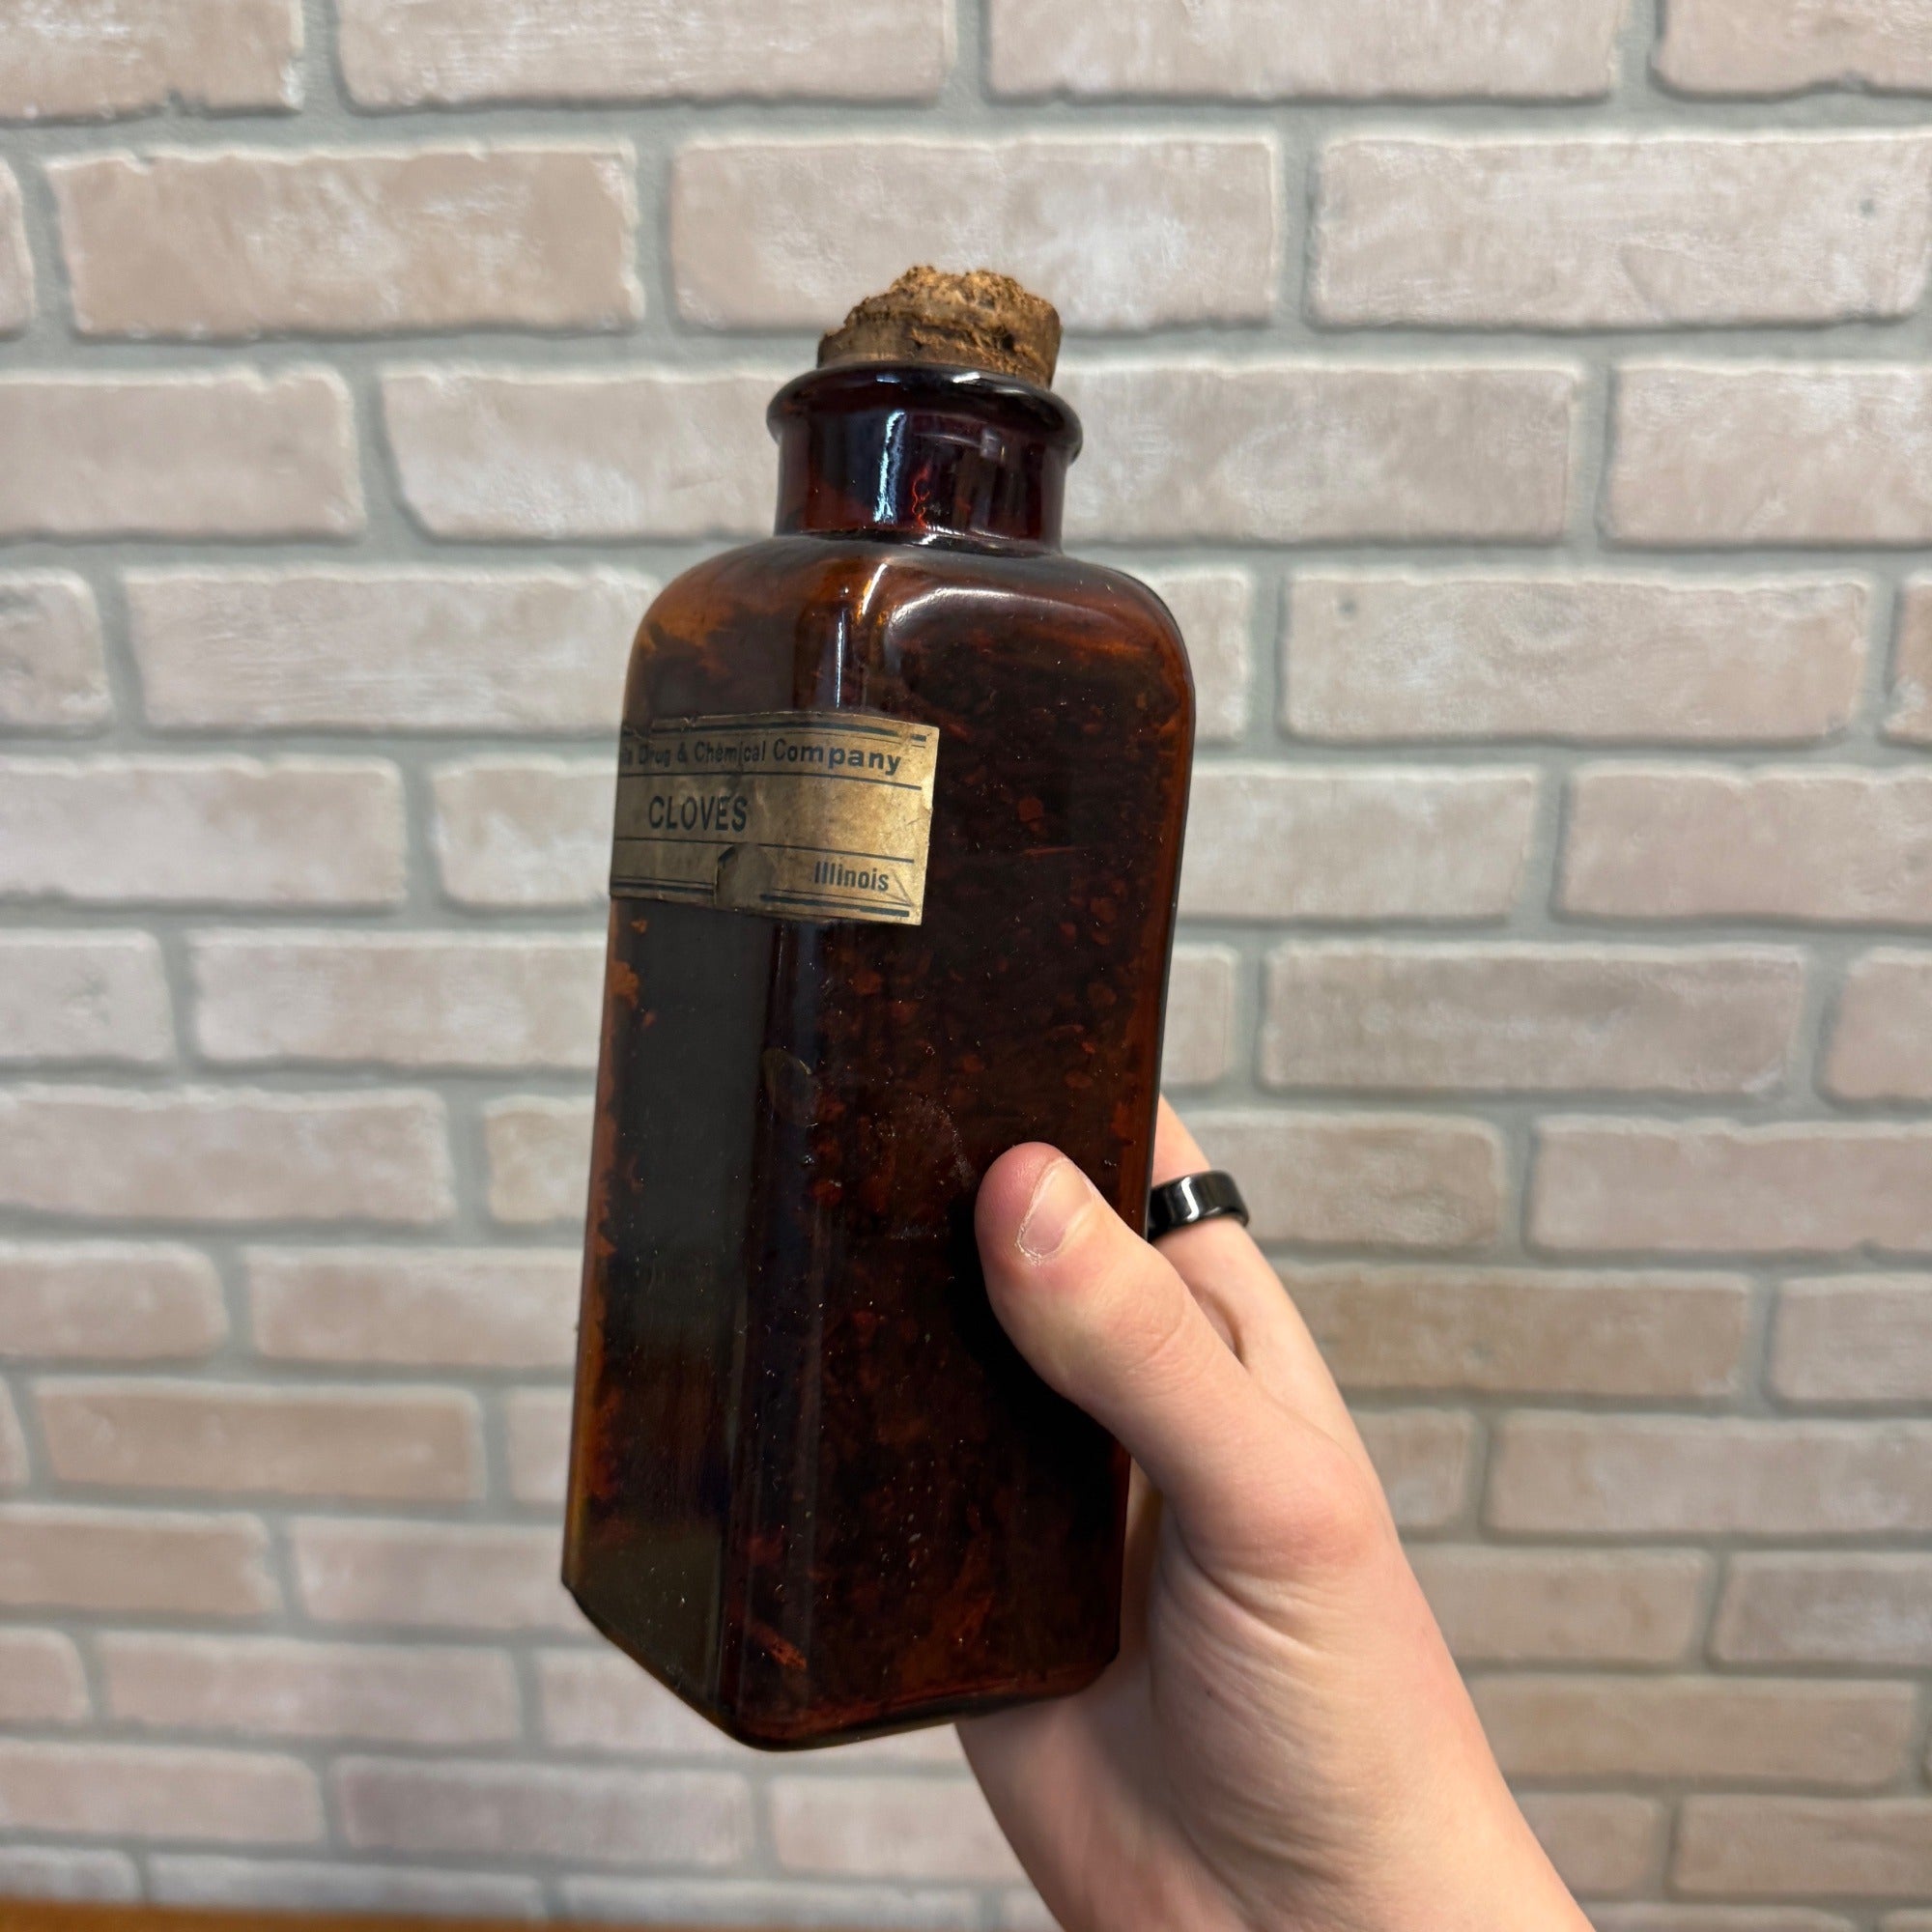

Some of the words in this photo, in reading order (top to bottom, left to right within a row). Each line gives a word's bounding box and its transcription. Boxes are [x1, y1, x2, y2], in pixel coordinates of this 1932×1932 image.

[639, 744, 671, 767] Drug
[677, 742, 688, 763] &
[694, 740, 766, 763] Chemical
[774, 738, 901, 775] Company
[648, 795, 748, 832] CLOVES
[814, 861, 890, 892] Illinois
